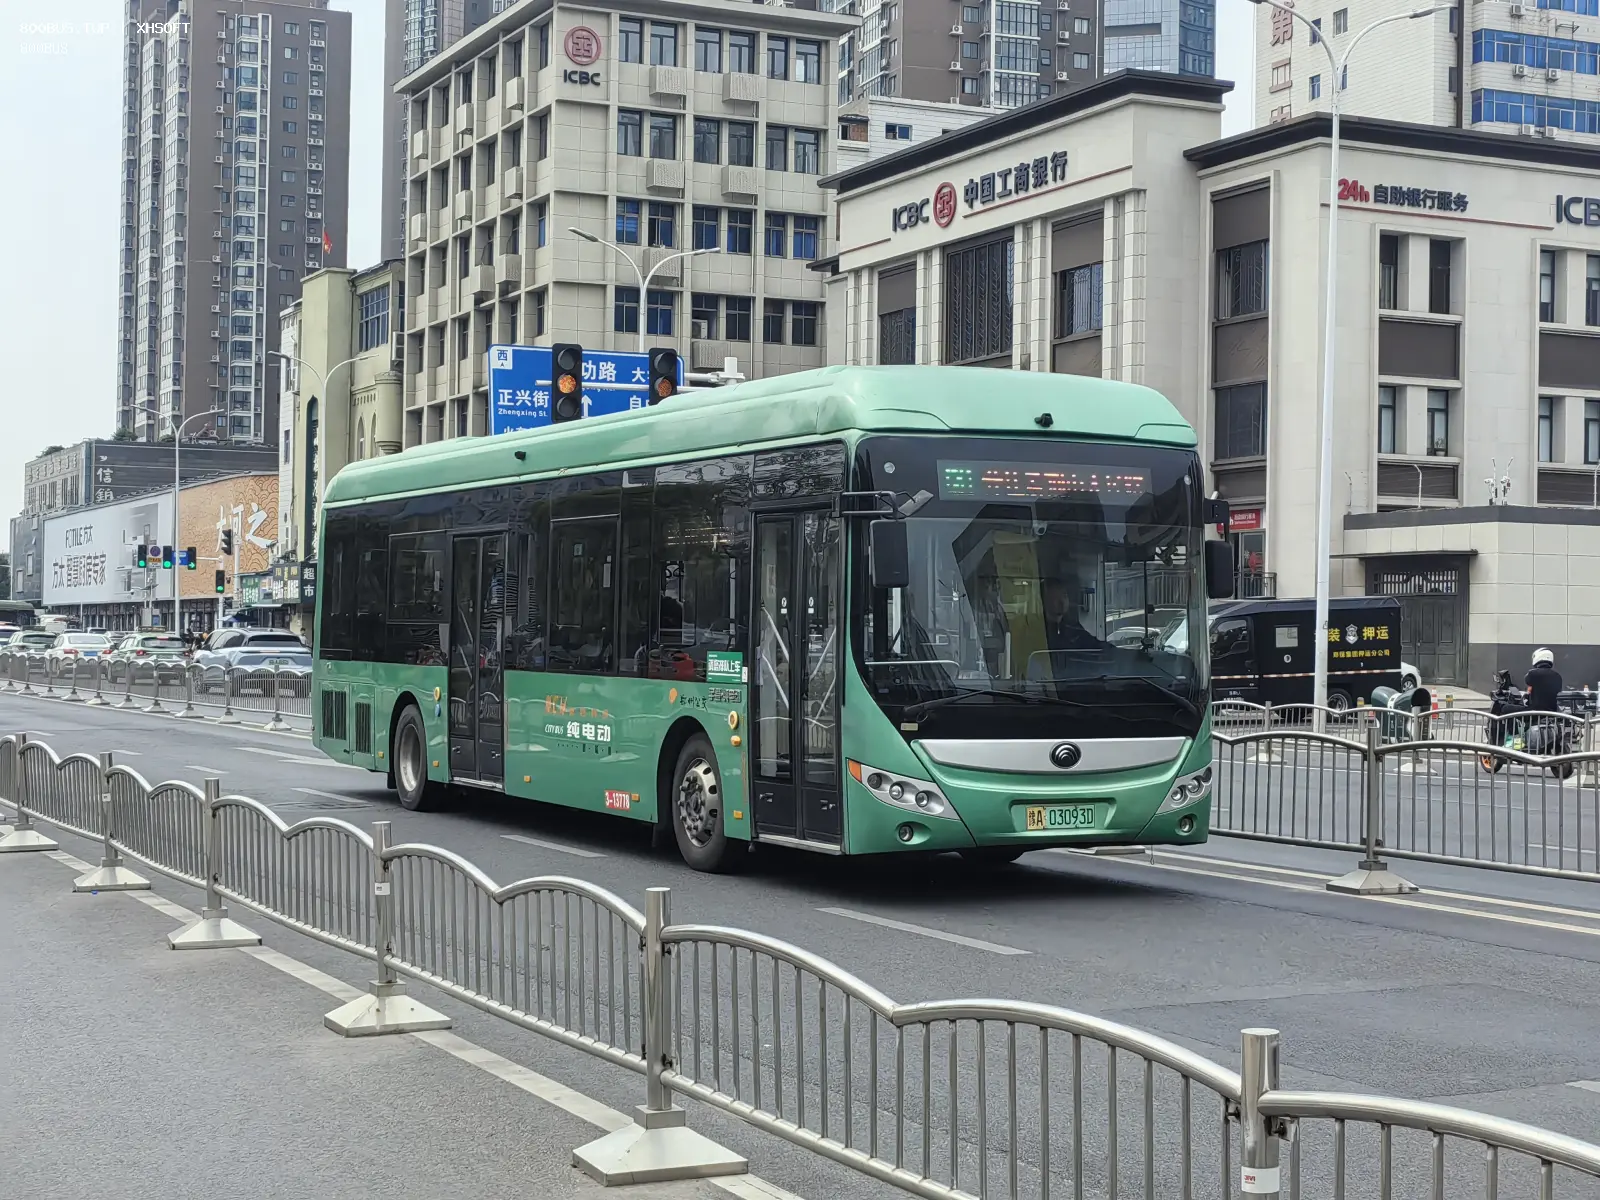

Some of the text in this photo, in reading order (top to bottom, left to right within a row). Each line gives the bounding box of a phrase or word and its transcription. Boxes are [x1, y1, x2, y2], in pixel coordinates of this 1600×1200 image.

[564, 69, 601, 86] ICBC
[892, 150, 1068, 232] ICBC 中国工商银行
[1338, 178, 1468, 212] 24h 自助银行服务
[496, 349, 508, 361] 西
[497, 389, 549, 408] 正兴街
[498, 408, 537, 418] Zhengxing
[1362, 626, 1389, 640] 押运
[566, 721, 611, 742] 纯电动
[605, 791, 630, 809] 3-13778
